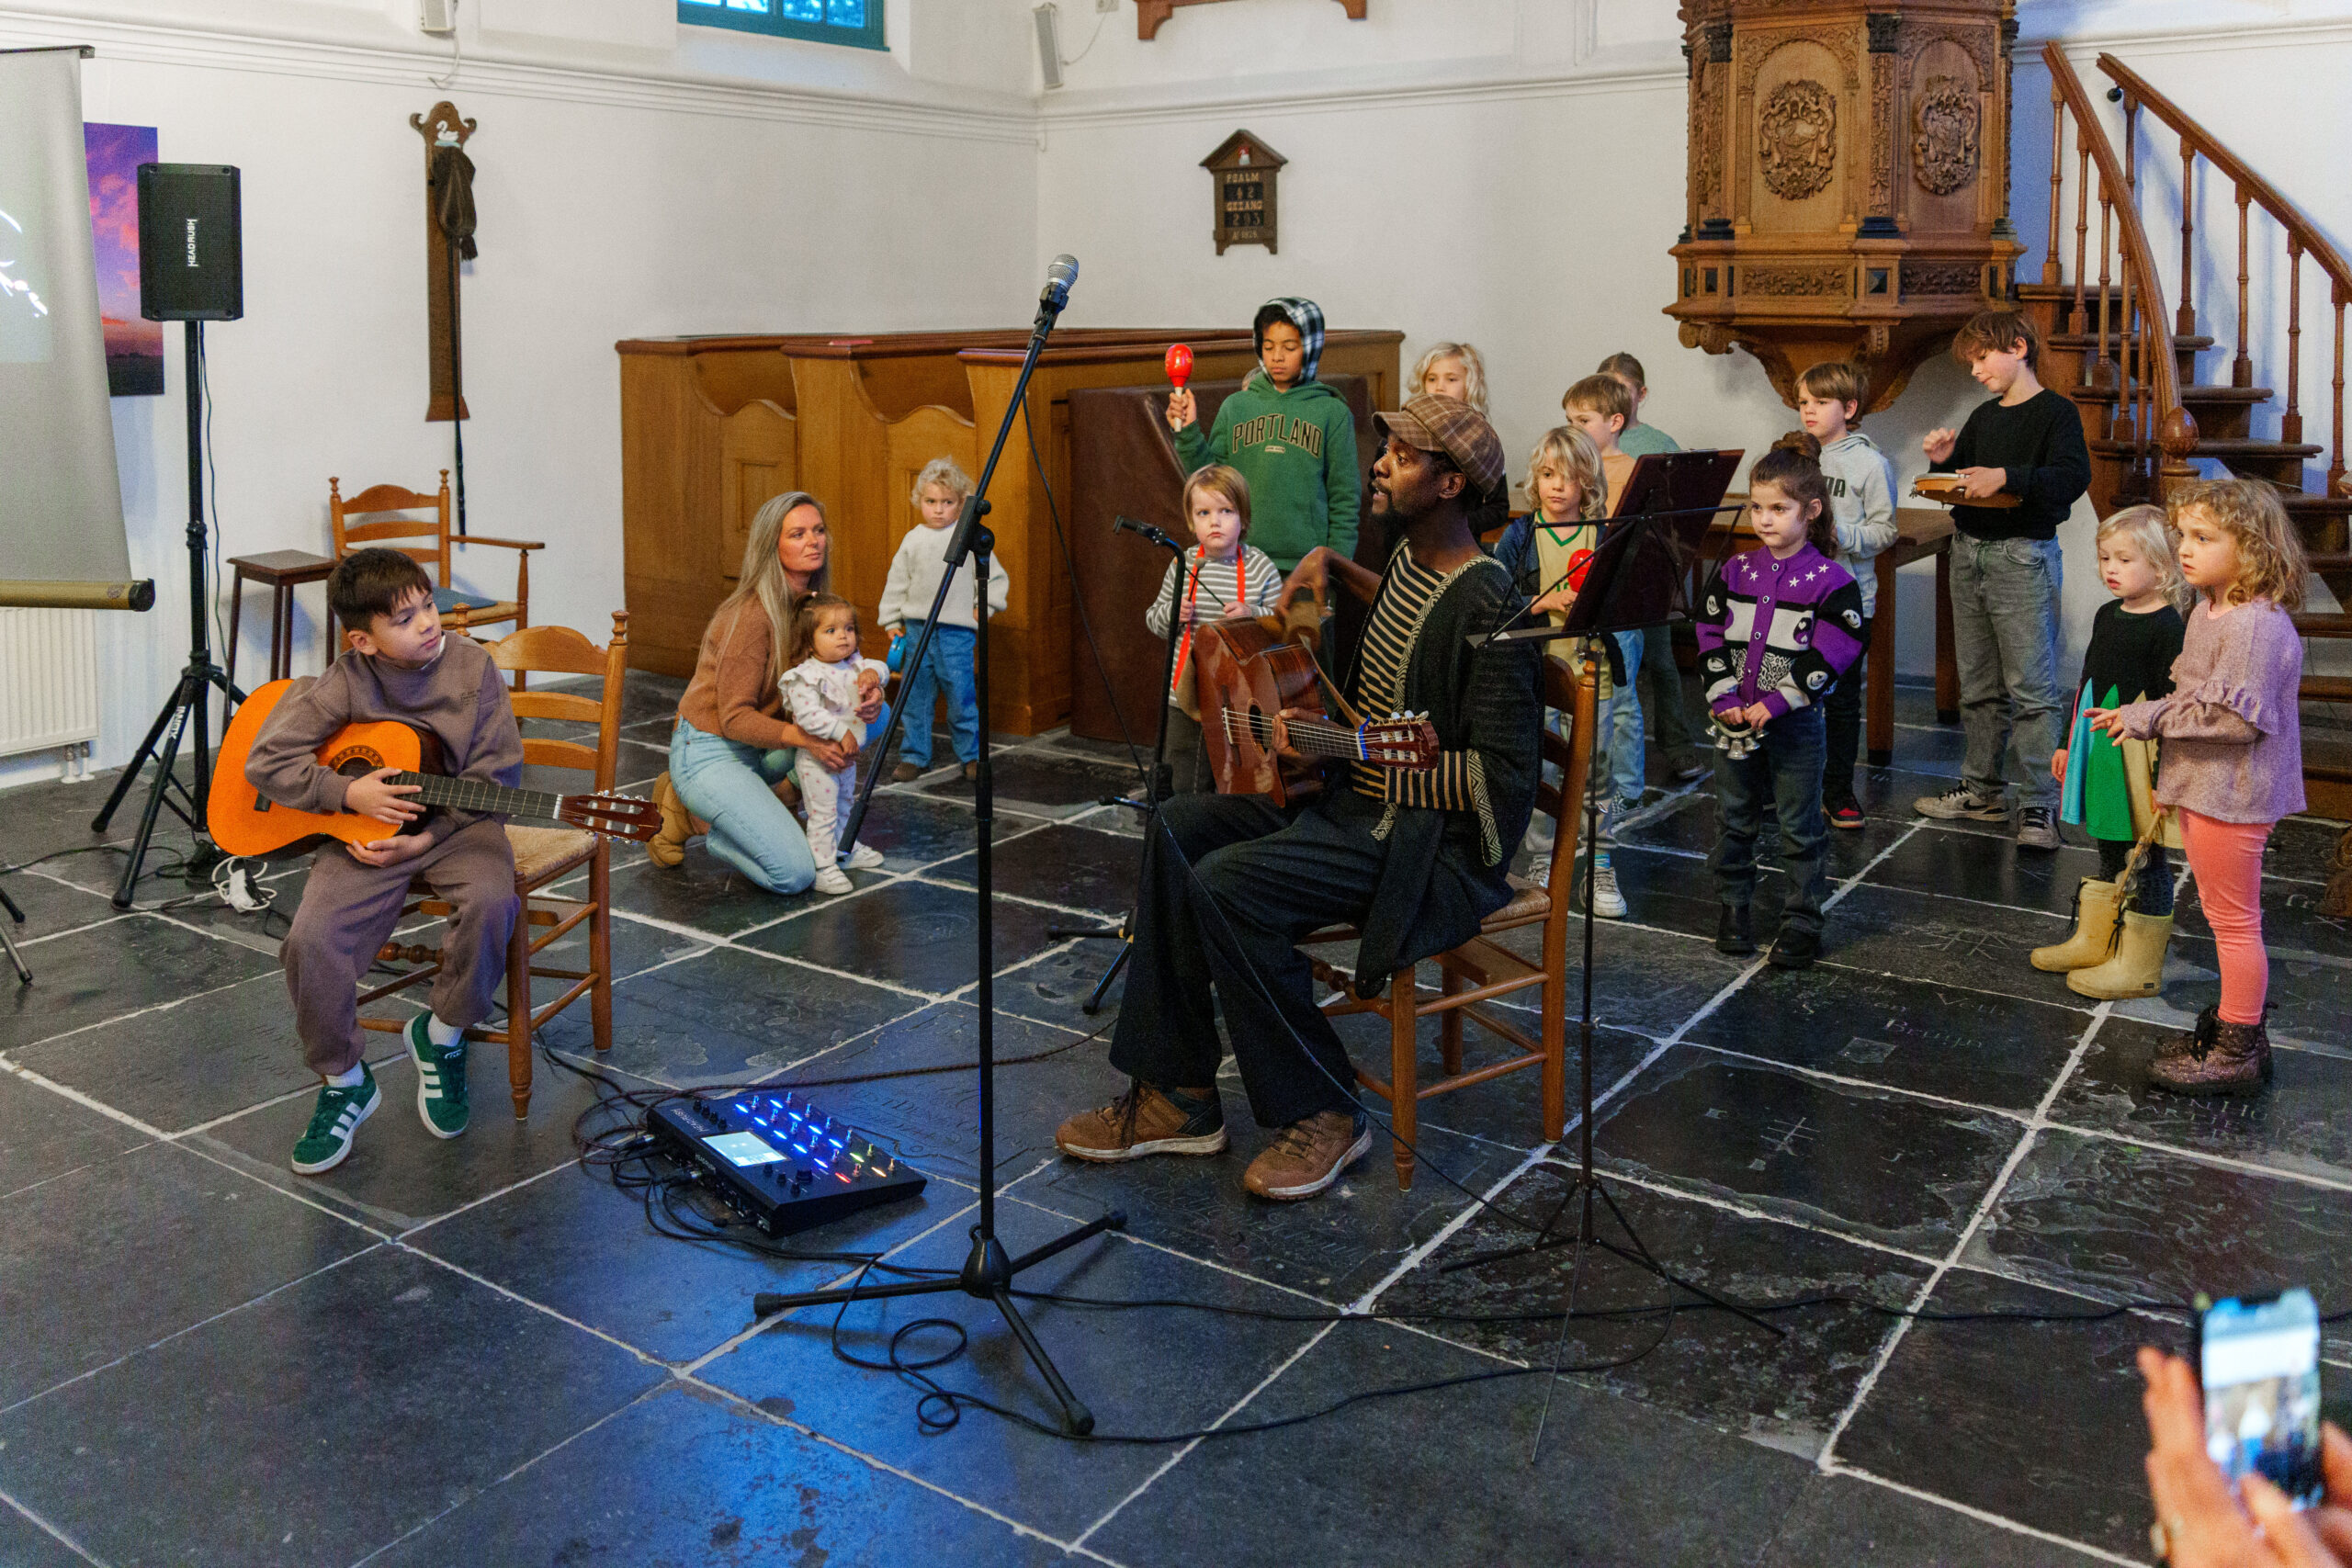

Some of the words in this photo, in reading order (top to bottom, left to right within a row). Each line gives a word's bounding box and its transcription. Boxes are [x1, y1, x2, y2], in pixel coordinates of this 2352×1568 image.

[1227, 173, 1260, 183] PSALM
[1227, 200, 1262, 212] GEZANG
[187, 220, 199, 267] HEADRUSH
[1232, 413, 1323, 458] PORTLAND
